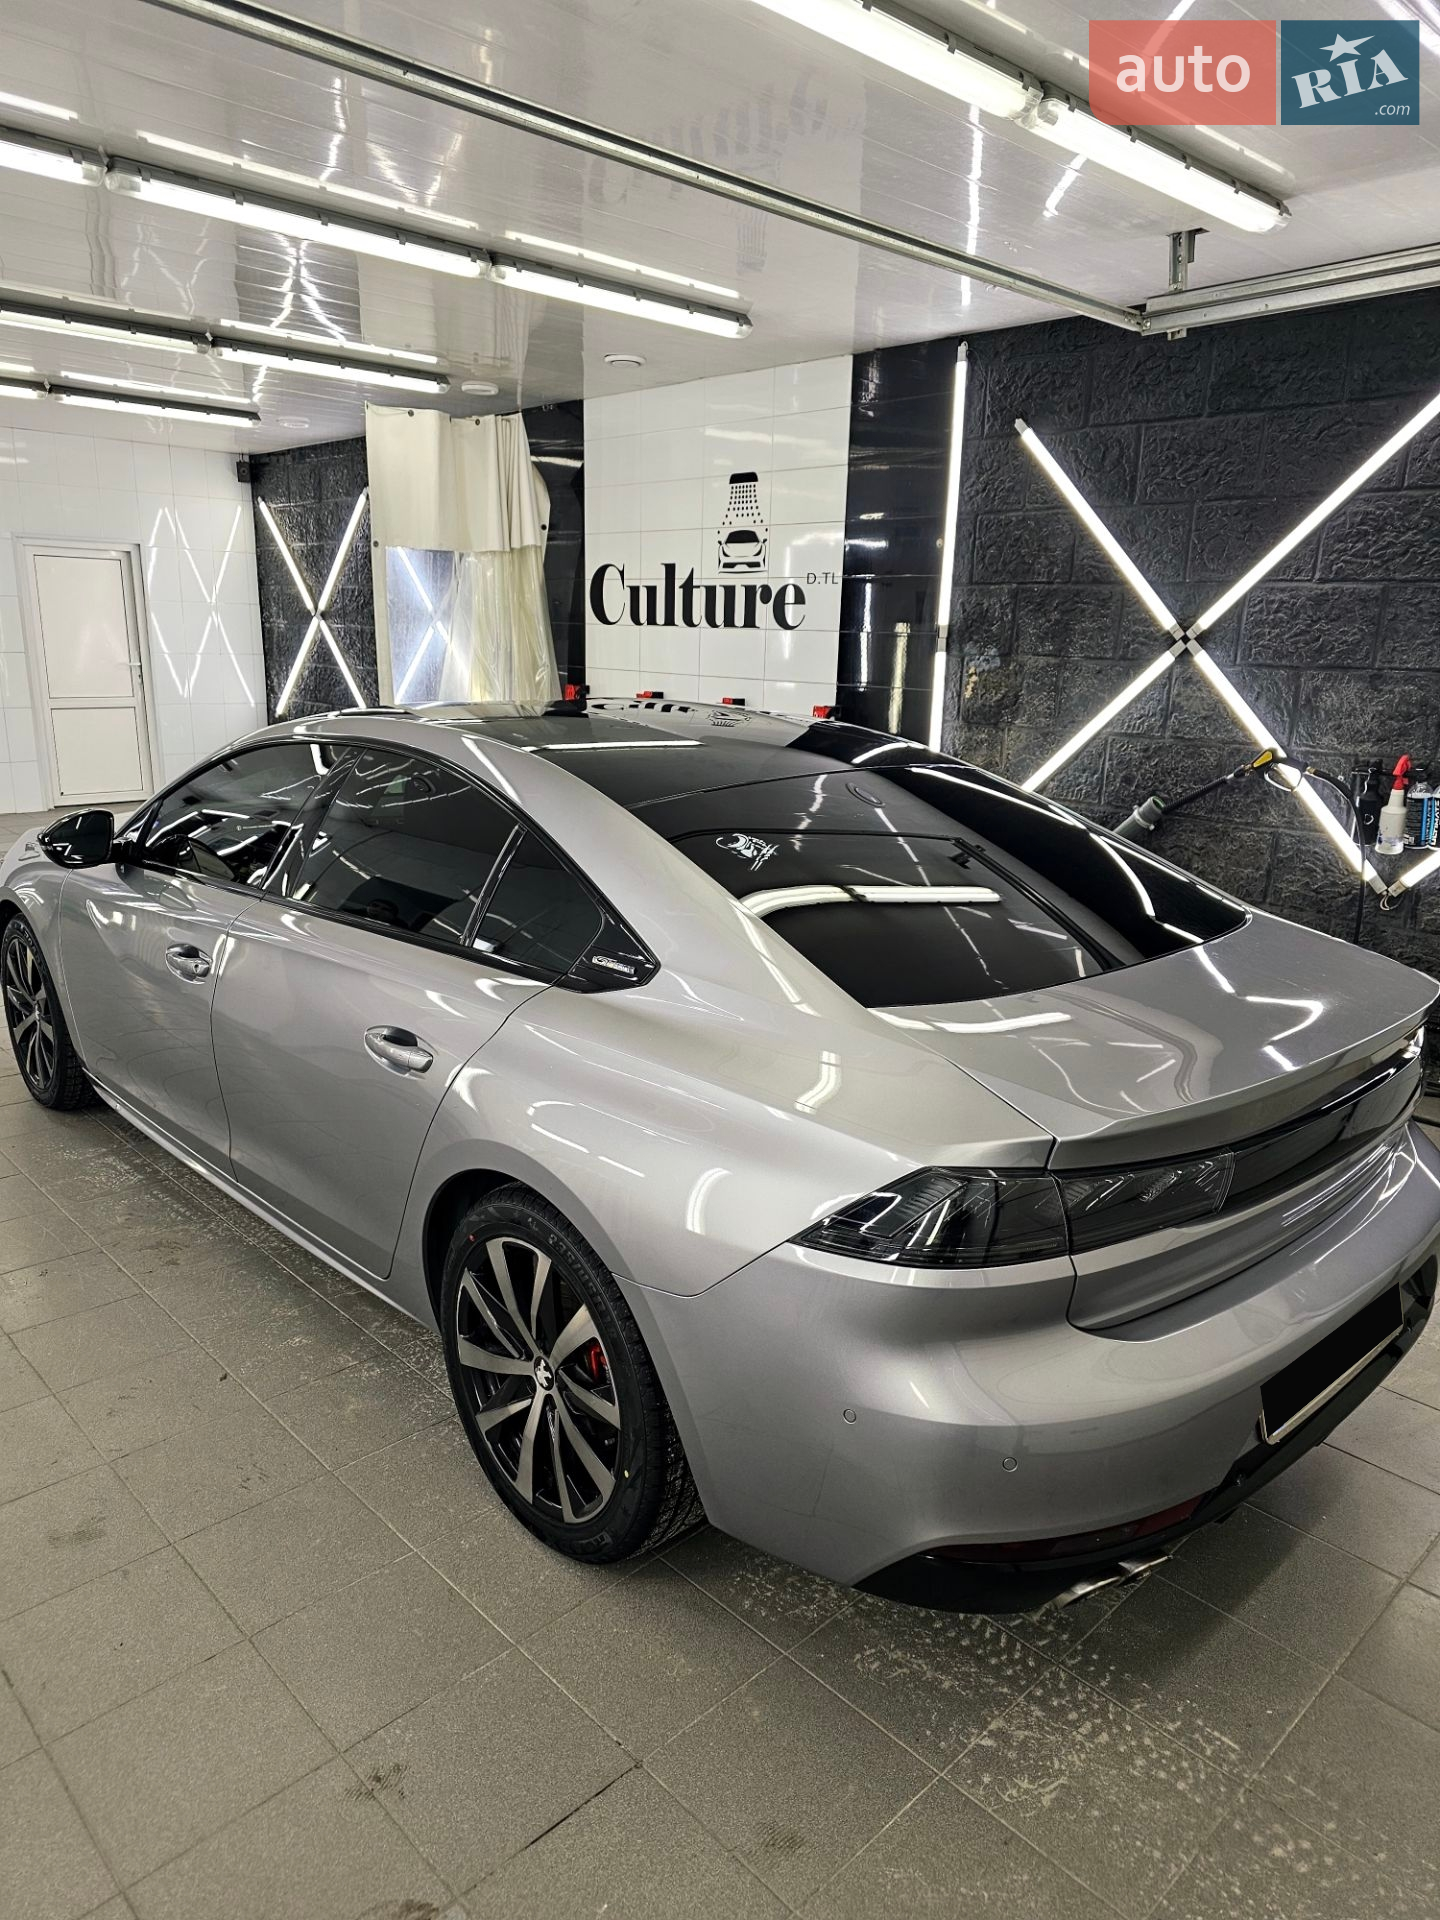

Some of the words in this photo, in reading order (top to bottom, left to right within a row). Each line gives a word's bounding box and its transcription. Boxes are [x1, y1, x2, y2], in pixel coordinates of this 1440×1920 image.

[589, 562, 806, 631] Culture
[806, 572, 839, 585] D.TL
[1430, 799, 1440, 846] ULTIMATE
